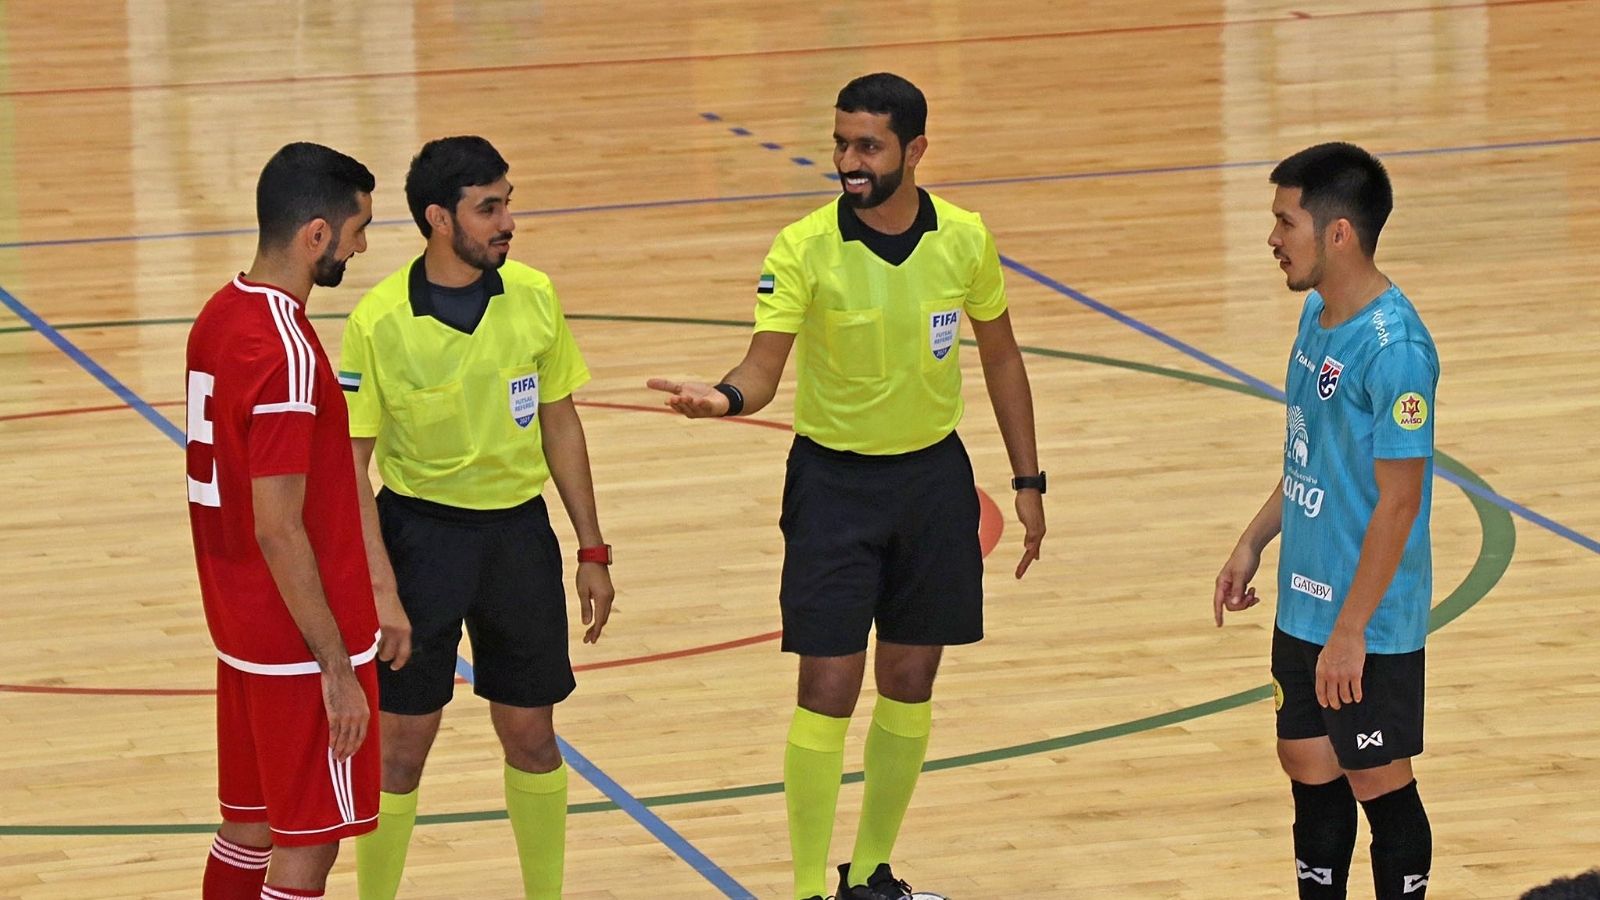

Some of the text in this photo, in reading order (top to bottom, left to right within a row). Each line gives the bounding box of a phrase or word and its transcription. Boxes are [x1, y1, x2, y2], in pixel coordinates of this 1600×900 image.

[932, 311, 957, 328] FIFA
[1372, 309, 1390, 347] Kubota
[511, 377, 536, 395] FIFA
[1293, 576, 1331, 599] GATSBY
